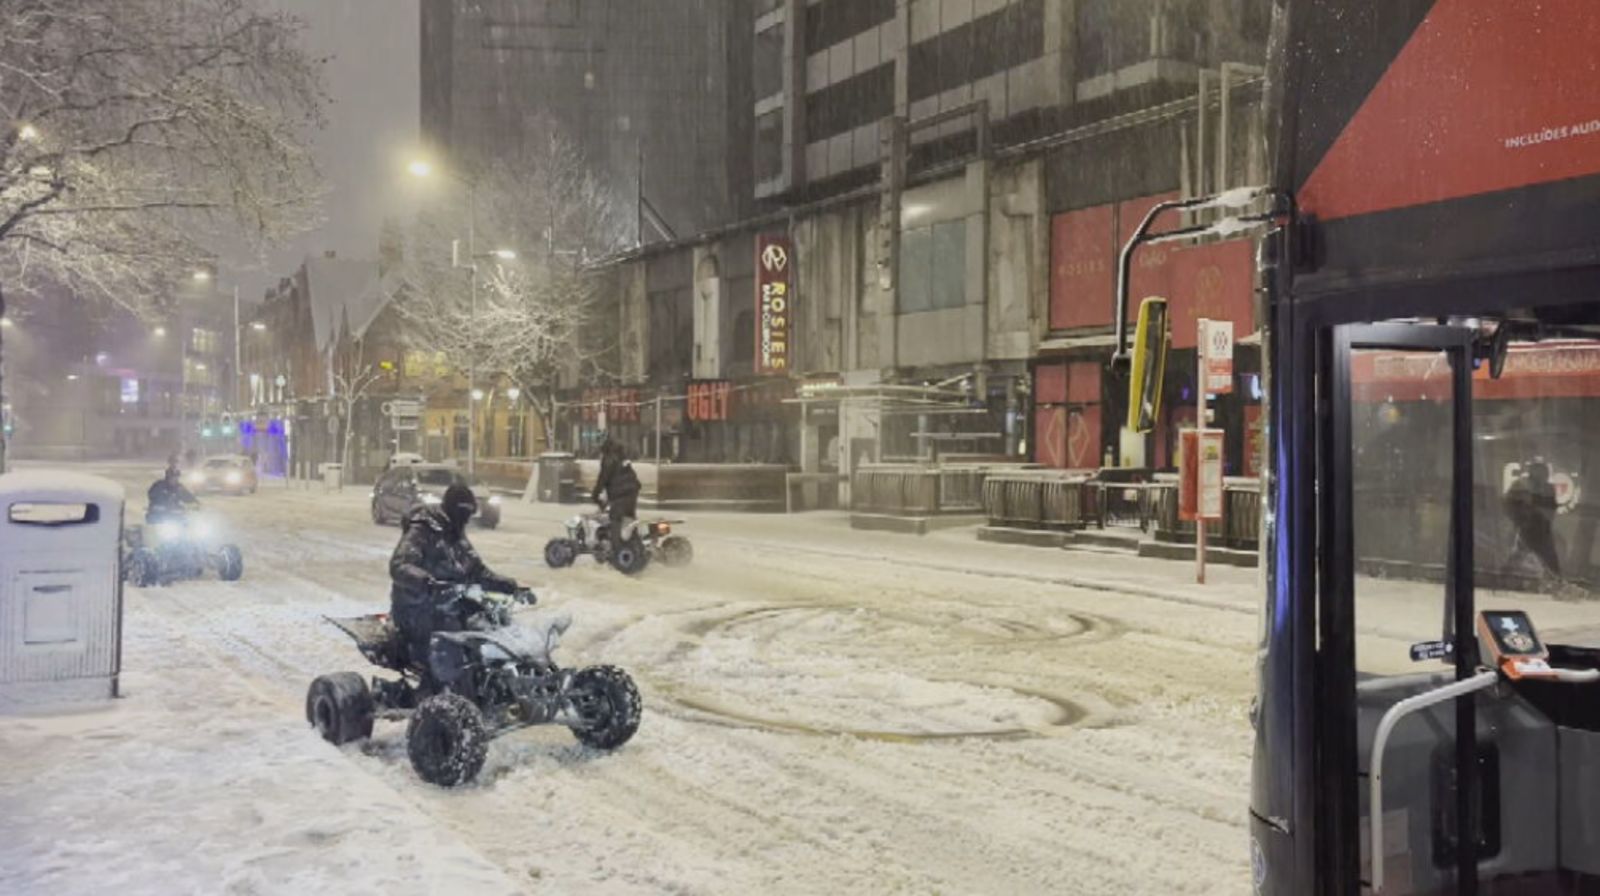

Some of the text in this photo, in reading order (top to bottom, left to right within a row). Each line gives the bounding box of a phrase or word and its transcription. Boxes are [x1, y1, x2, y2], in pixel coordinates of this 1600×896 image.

[1505, 126, 1567, 149] INCLUDES
[771, 282, 786, 369] ROSIES
[687, 381, 729, 421] UGLY
